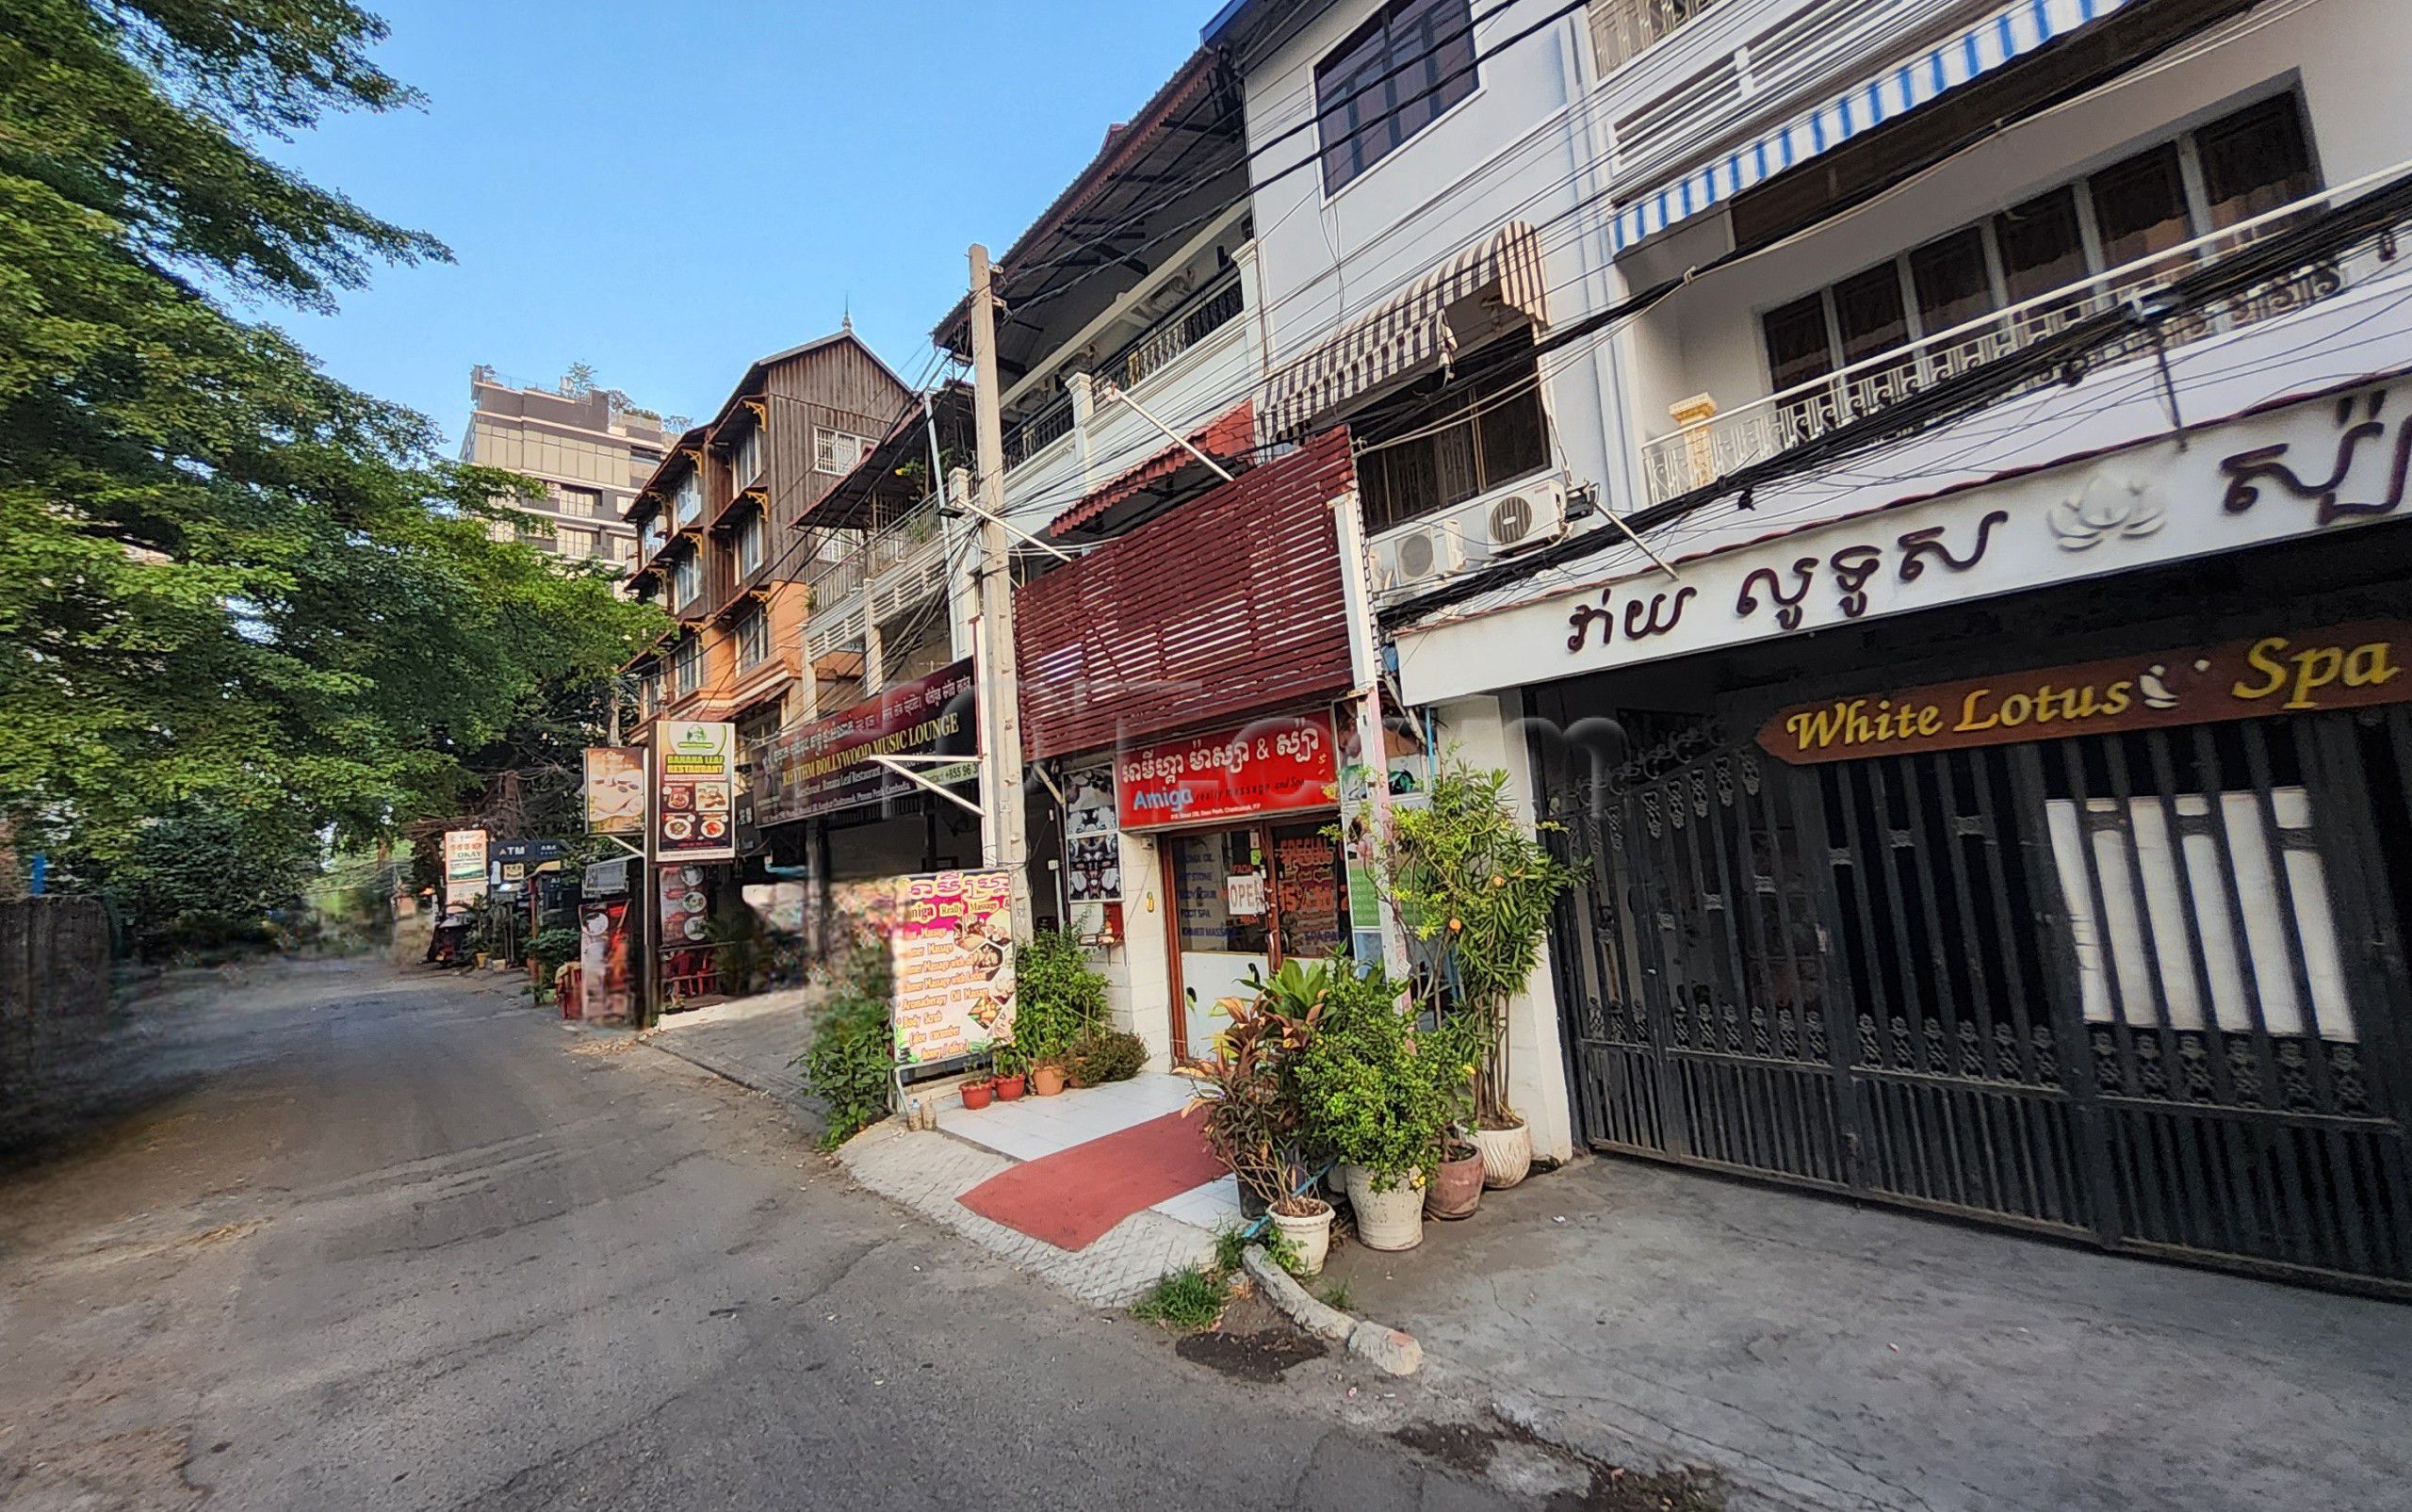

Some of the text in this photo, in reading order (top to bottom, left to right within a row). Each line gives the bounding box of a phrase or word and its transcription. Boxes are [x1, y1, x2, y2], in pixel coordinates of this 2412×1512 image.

[1785, 636, 2403, 753] White Lotus Spa
[782, 758, 816, 787] RHYTHM
[816, 741, 872, 776] BOLLYWOOD
[875, 731, 908, 756] MUSIC
[908, 712, 959, 746] LOUNGE
[1256, 737, 1270, 760] &
[705, 755, 725, 765] LEAF
[667, 764, 725, 774] RESTAURANT
[945, 767, 962, 780] +855
[962, 764, 971, 776] 96
[1133, 786, 1194, 812] Amiga
[1275, 778, 1290, 790] and
[498, 846, 525, 855] ATM
[1229, 883, 1264, 908] OPEN
[941, 903, 962, 917] Really
[970, 901, 998, 913] Massage
[928, 943, 953, 953] Massage
[923, 960, 950, 972] Massage
[924, 977, 951, 988] Massage
[903, 987, 989, 1010] Aromatherapy Oil Massage
[903, 1011, 942, 1028] Body Scrub
[921, 1048, 941, 1060] honey
